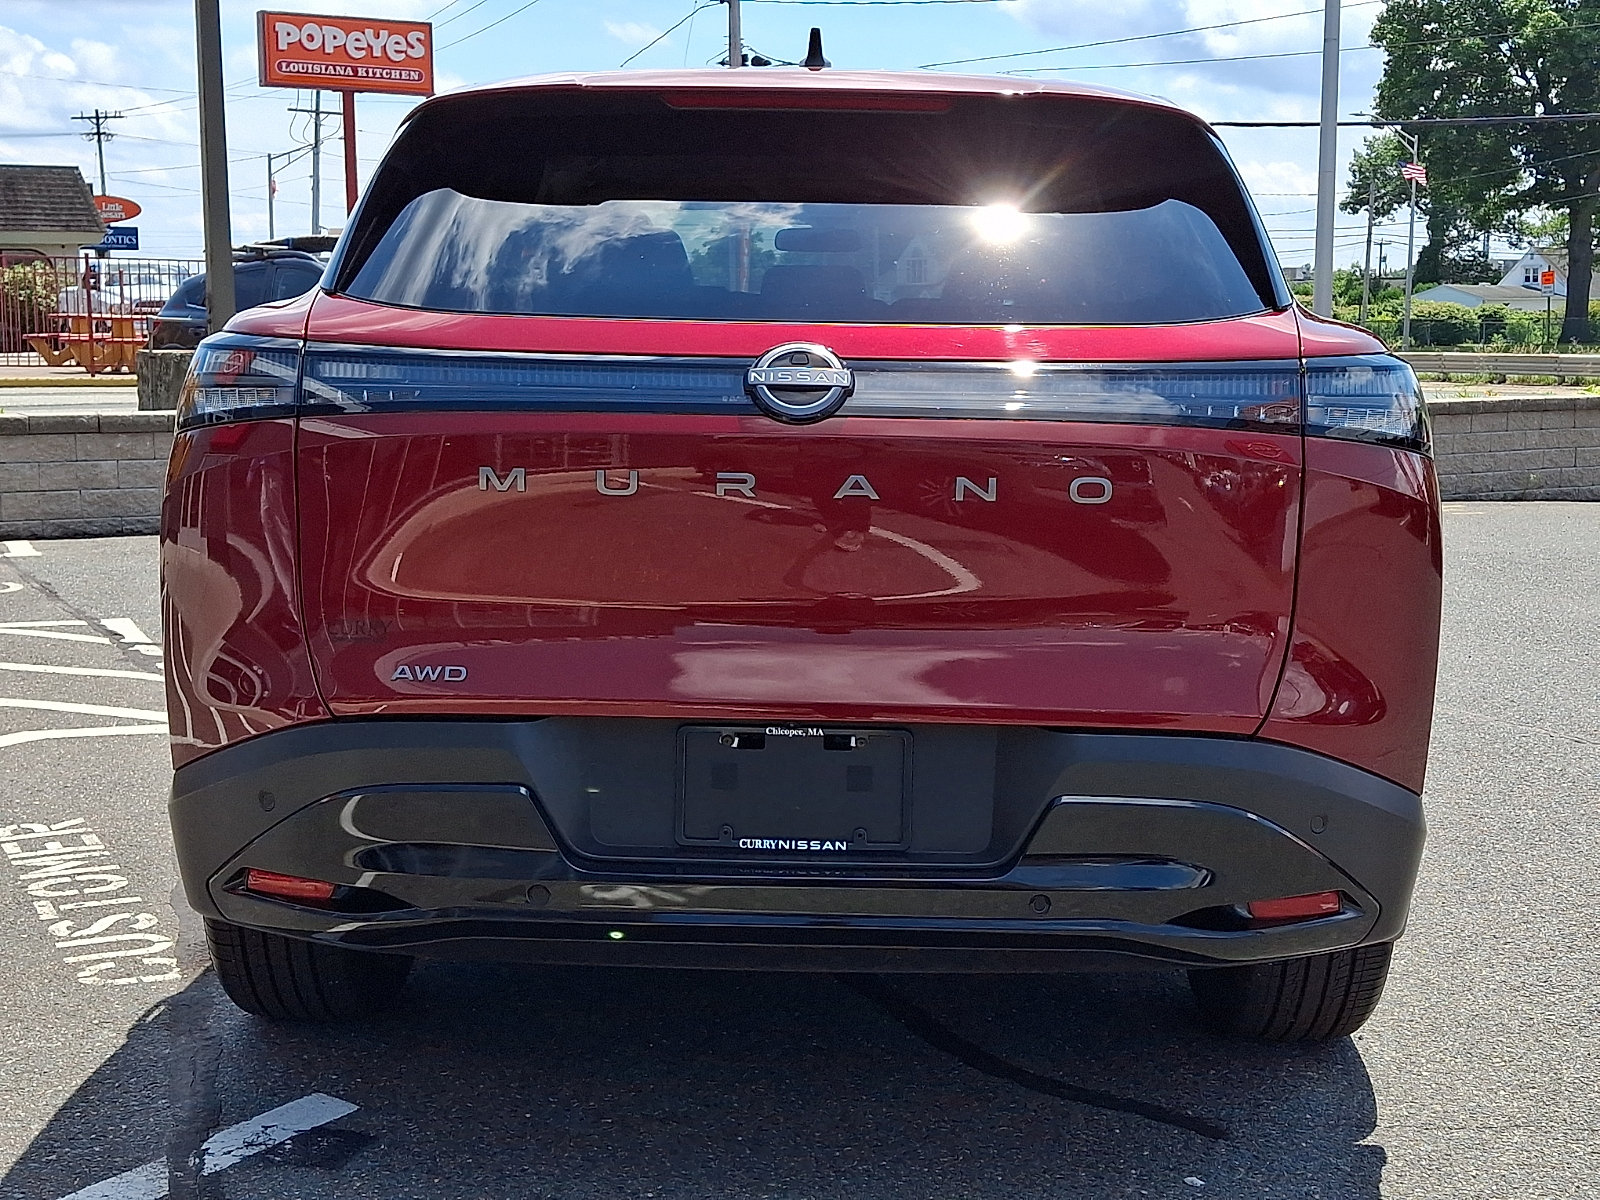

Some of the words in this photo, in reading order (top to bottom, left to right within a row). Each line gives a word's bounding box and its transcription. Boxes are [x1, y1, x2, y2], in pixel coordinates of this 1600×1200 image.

[281, 62, 353, 76] LOUISIANA
[357, 67, 420, 80] KITCHEN
[102, 202, 123, 211] Little
[750, 371, 849, 384] NISSAN
[390, 665, 468, 682] AWD
[765, 727, 806, 738] Chicopee,
[807, 728, 824, 737] MA
[0, 817, 182, 985] CUSTOMER
